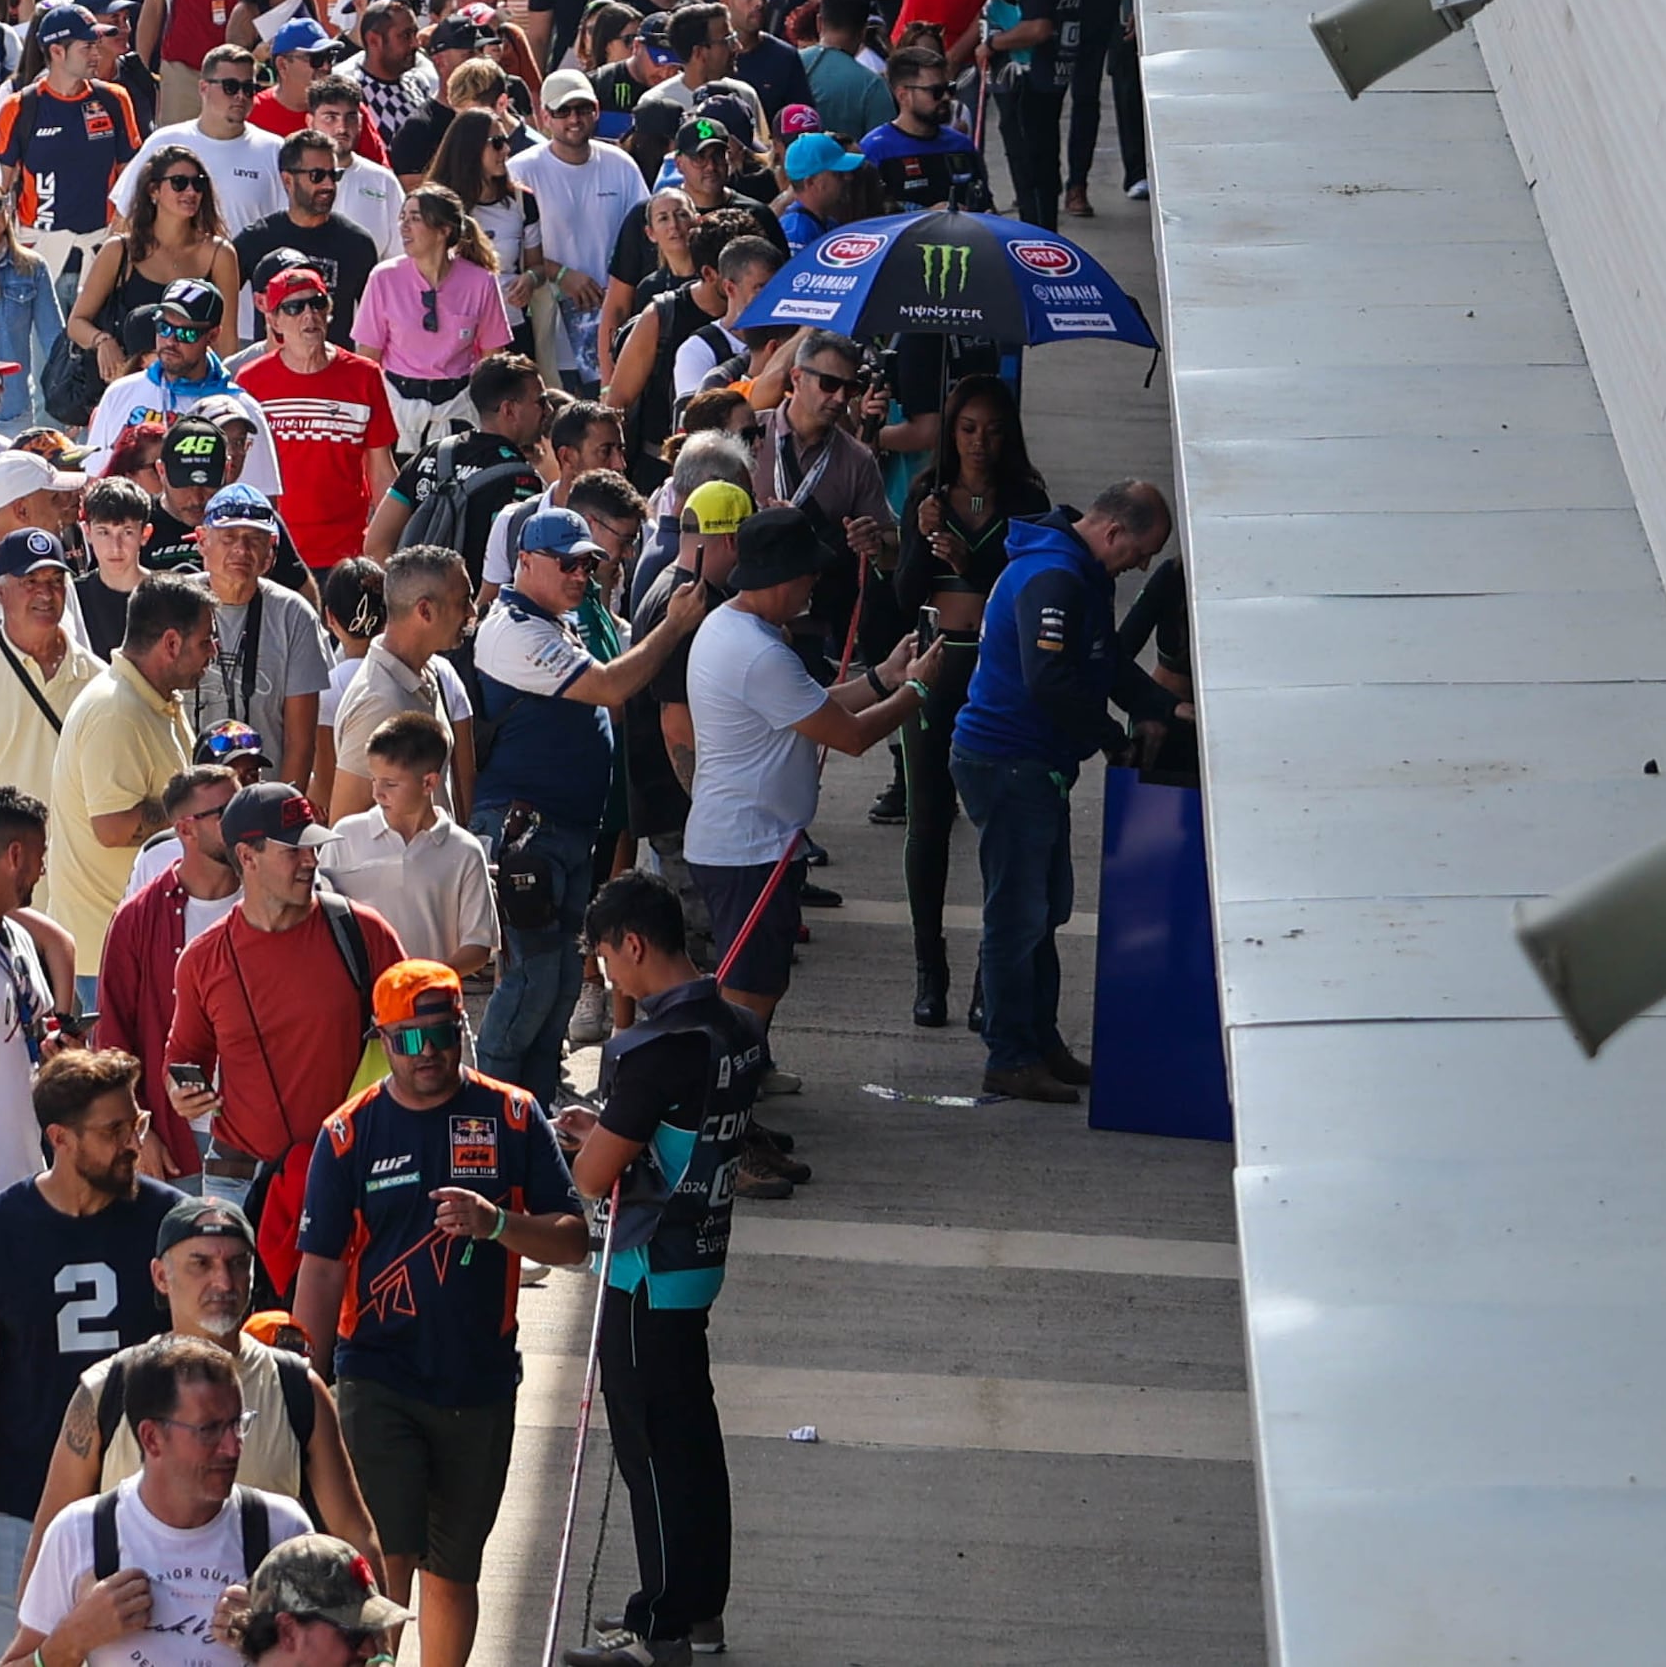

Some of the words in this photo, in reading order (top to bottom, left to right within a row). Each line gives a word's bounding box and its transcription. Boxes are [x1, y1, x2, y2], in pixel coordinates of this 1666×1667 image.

[834, 240, 873, 256] PATA
[1022, 250, 1062, 264] PATA
[809, 274, 859, 292] YAMAHA
[1046, 284, 1103, 301] YAMAHA
[899, 305, 984, 320] MONSTER
[173, 435, 217, 455] 46
[52, 1261, 121, 1354] 2
